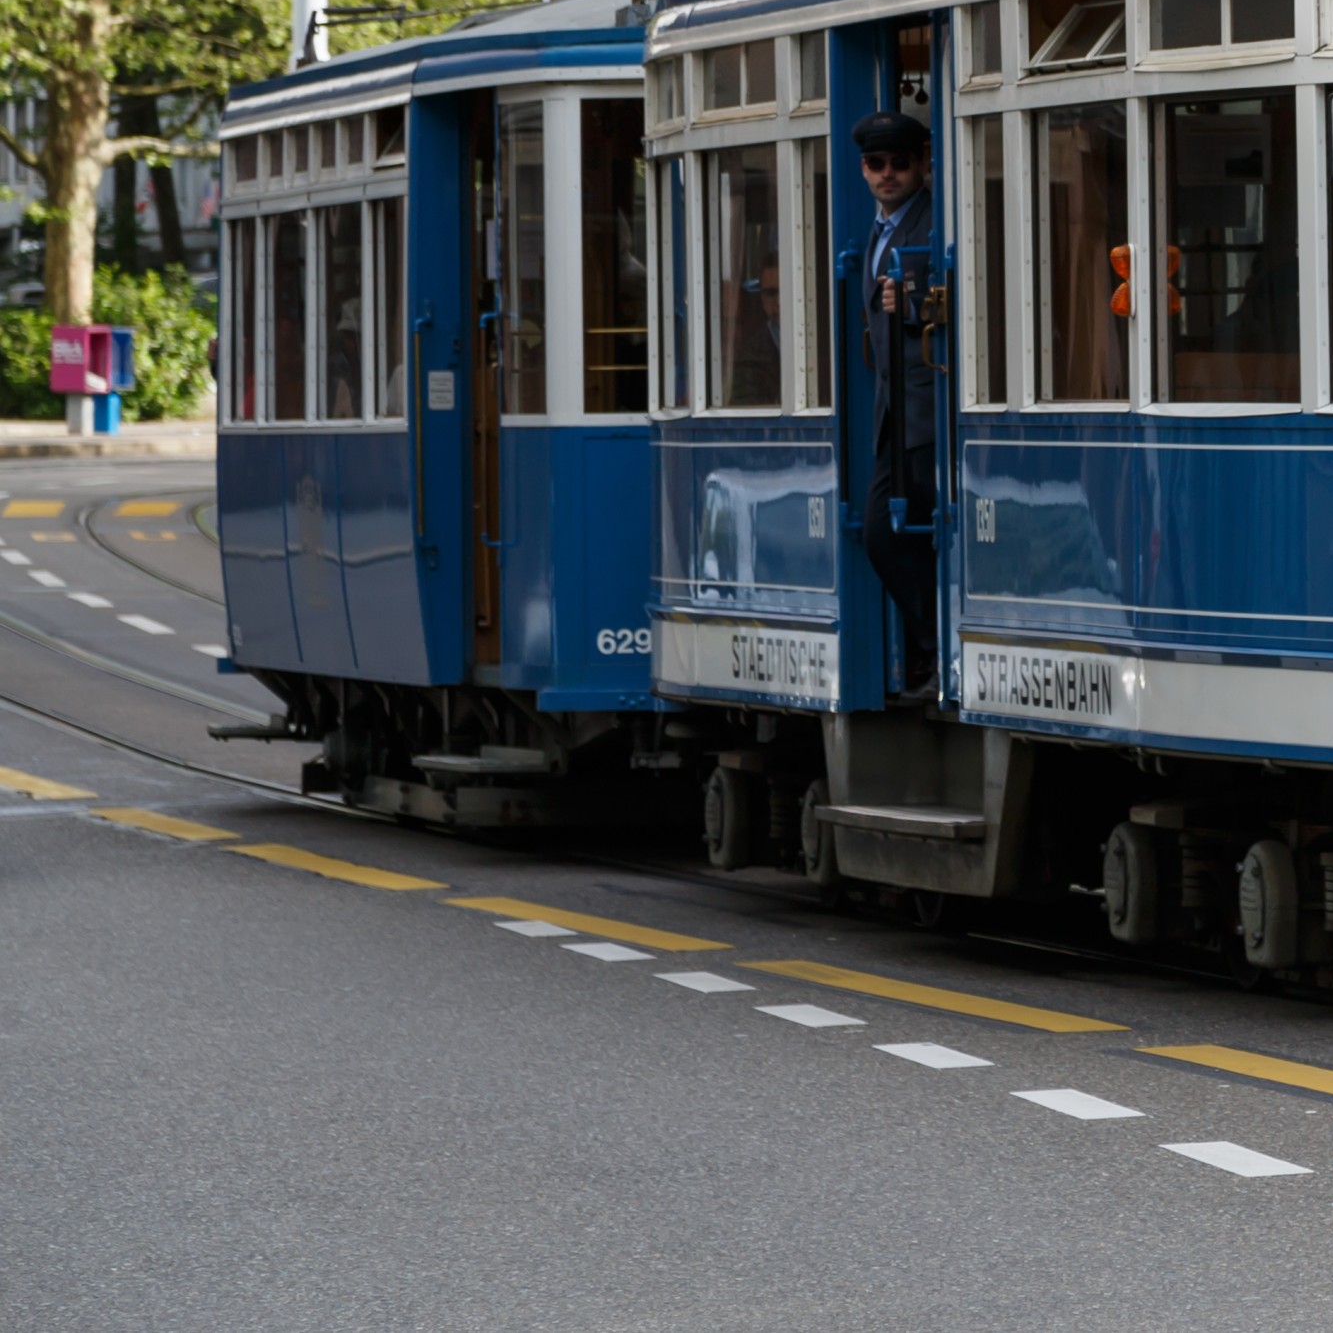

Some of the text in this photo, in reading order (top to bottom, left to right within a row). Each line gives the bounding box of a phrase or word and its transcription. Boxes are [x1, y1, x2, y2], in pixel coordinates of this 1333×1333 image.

[808, 497, 825, 539] 1350
[976, 499, 996, 543] 1350
[597, 629, 652, 655] 629
[732, 634, 826, 688] STAEDTISCHE
[977, 653, 1112, 716] STRASSENBAHN
